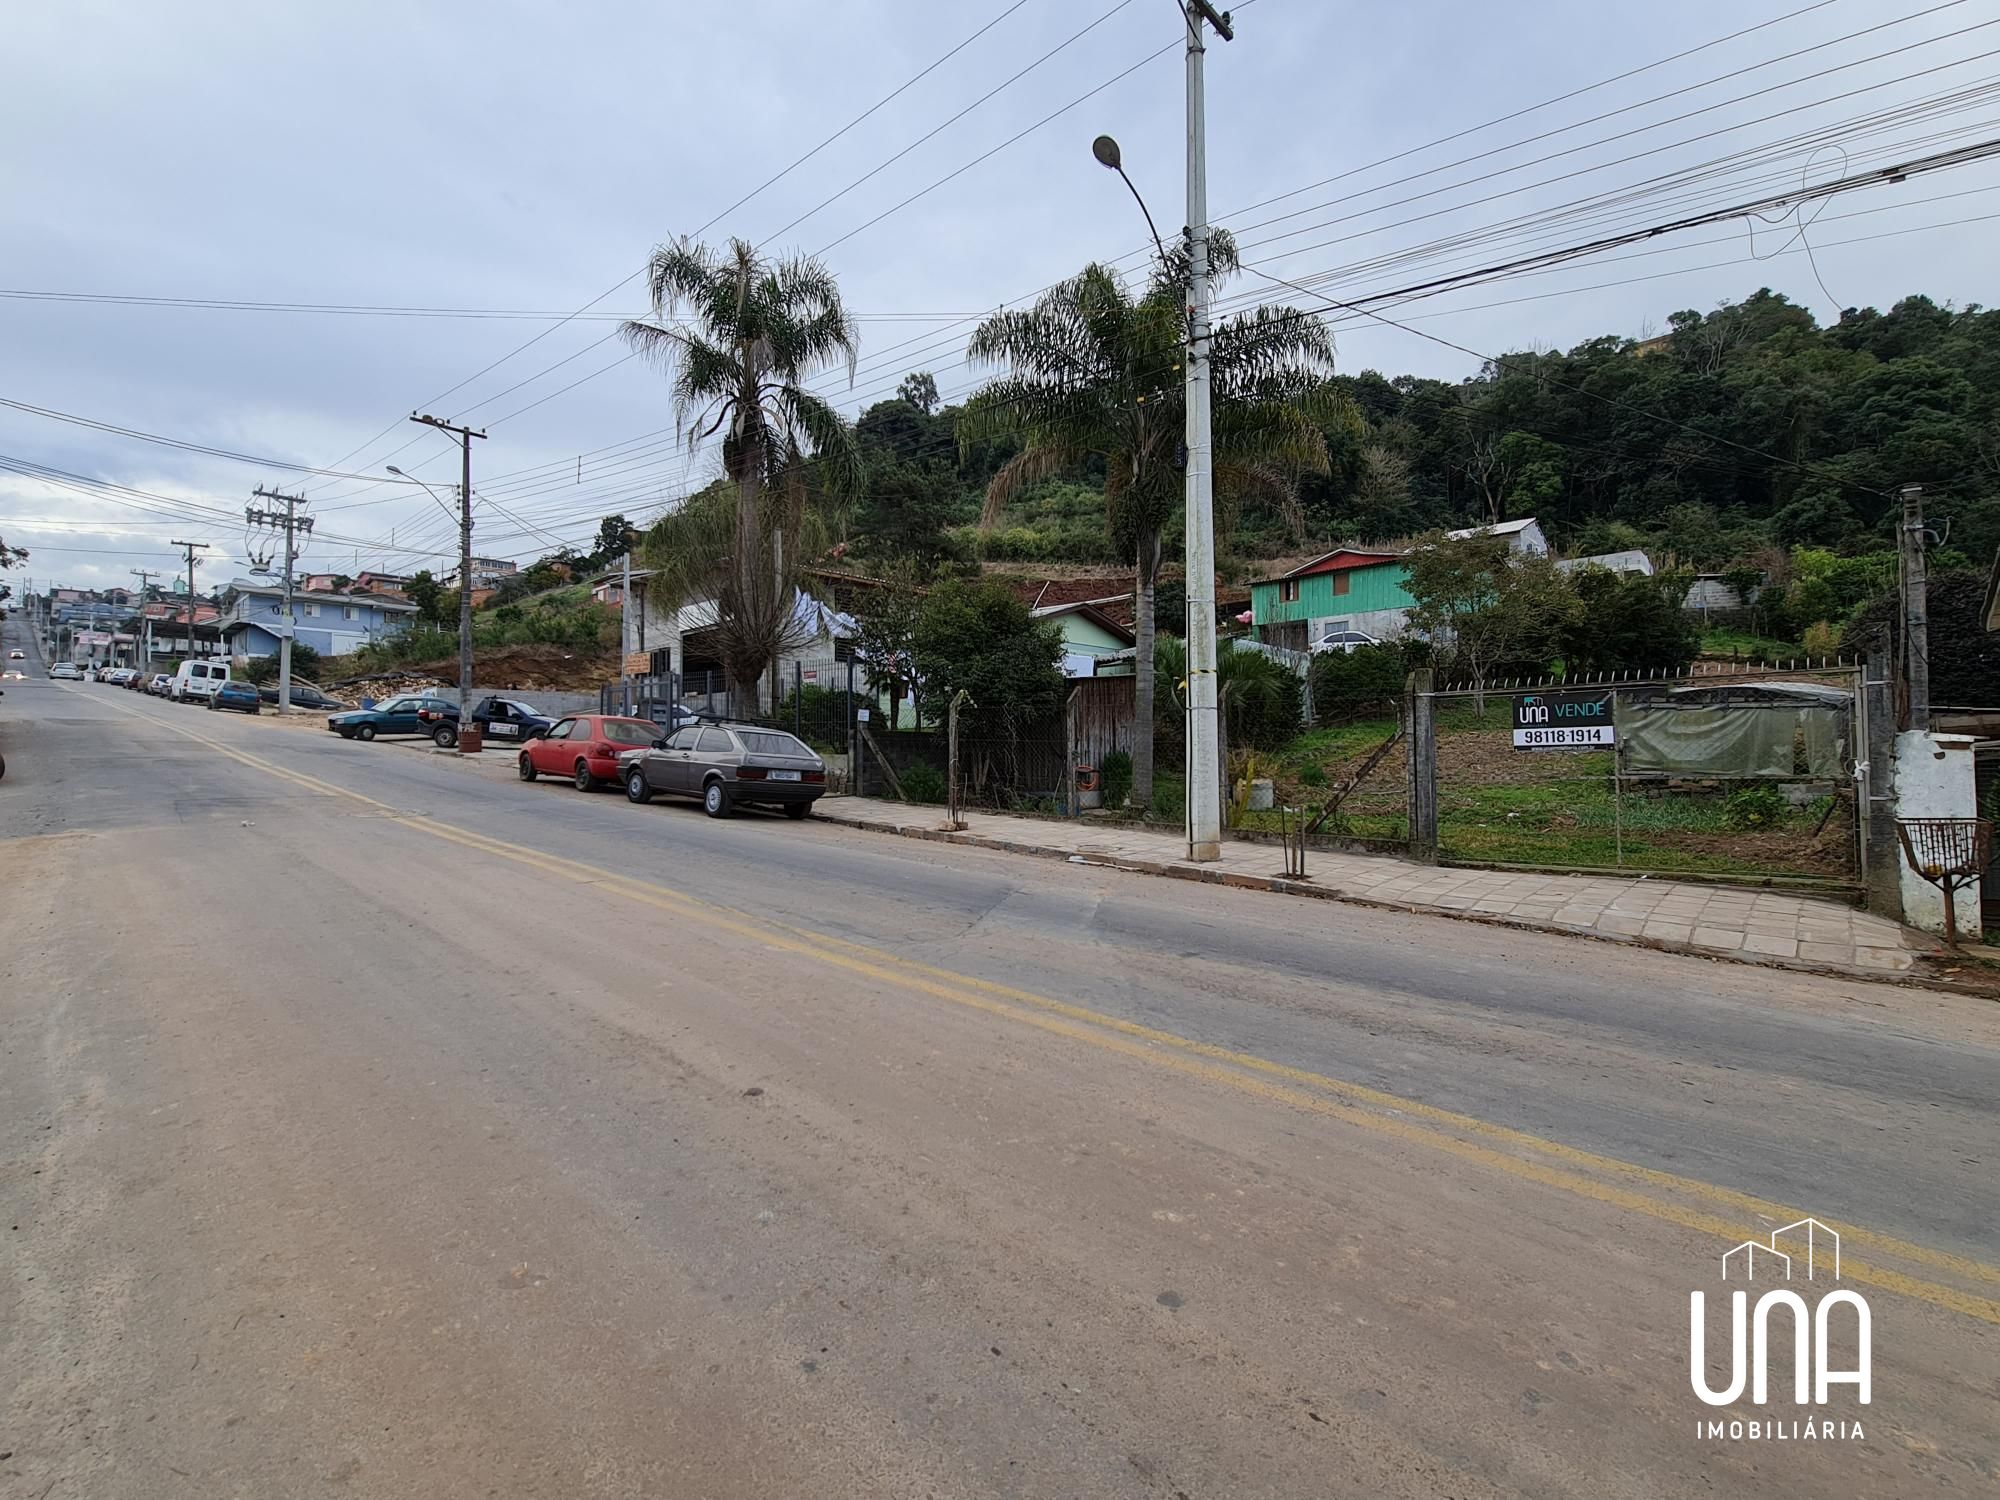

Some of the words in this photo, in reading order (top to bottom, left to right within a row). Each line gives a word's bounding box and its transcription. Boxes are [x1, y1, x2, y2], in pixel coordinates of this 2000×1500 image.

[1519, 706, 1549, 724] UNA
[1555, 701, 1605, 718] VENDE
[1525, 729, 1601, 743] 98118-1914
